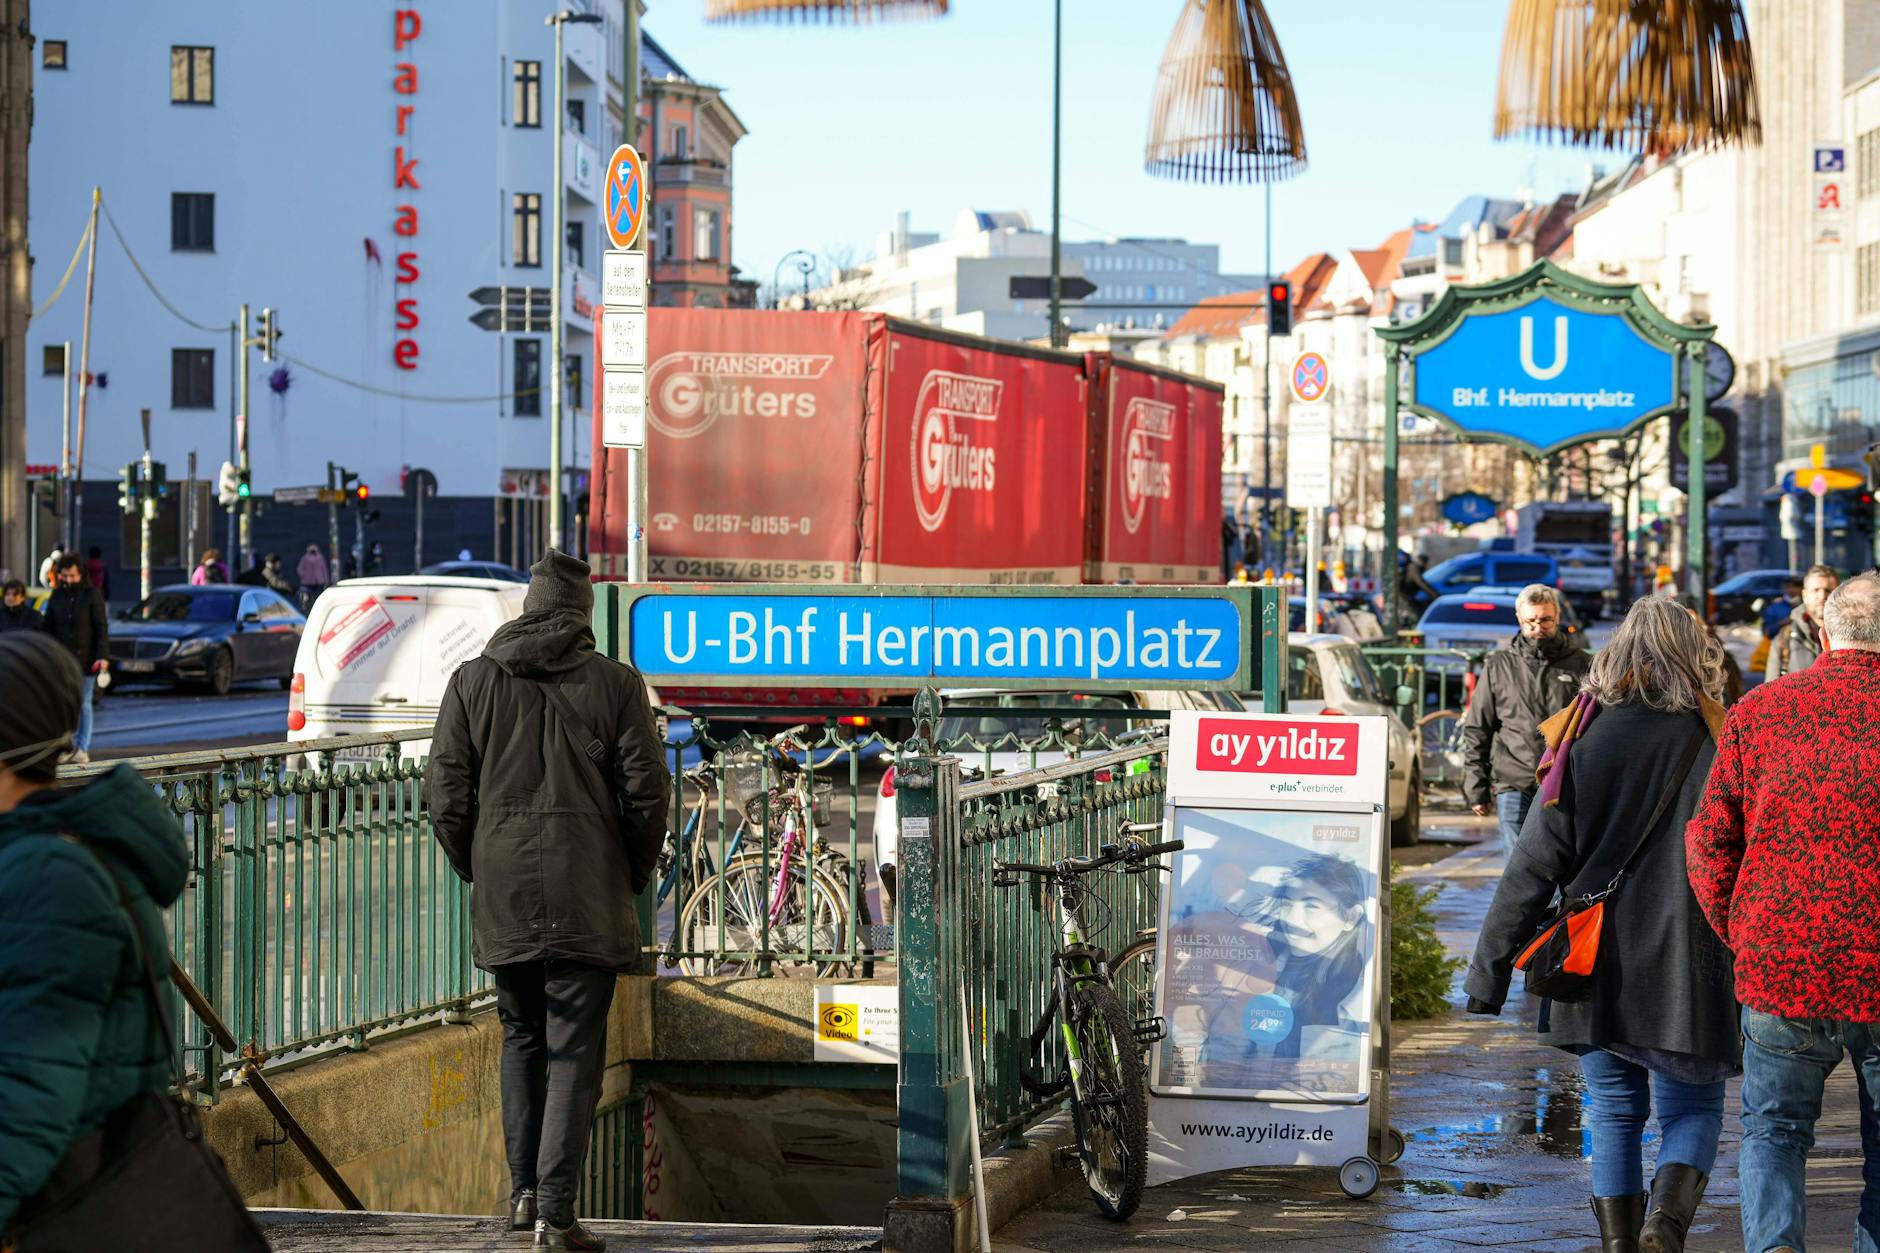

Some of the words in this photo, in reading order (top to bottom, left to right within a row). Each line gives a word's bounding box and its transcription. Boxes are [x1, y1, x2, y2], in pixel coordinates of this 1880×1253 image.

[1520, 316, 1568, 380] U
[689, 355, 814, 376] TRANSPORT
[663, 375, 817, 418] Grüters
[937, 377, 995, 414] TRANSPORT
[1453, 388, 1490, 406] Bhf.
[1498, 388, 1635, 411] Hermannplatz
[921, 415, 996, 492] Grüters
[693, 514, 811, 535] 02157-8155-0
[675, 560, 835, 580] 02157/8155-55
[663, 606, 817, 665] U-Bhf
[840, 610, 1221, 680] Hermannplatz
[1210, 733, 1251, 766] ay
[1218, 935, 1246, 945] WAS
[825, 1029, 853, 1039] Video
[1181, 1123, 1334, 1146] www.ayyildiz.de
